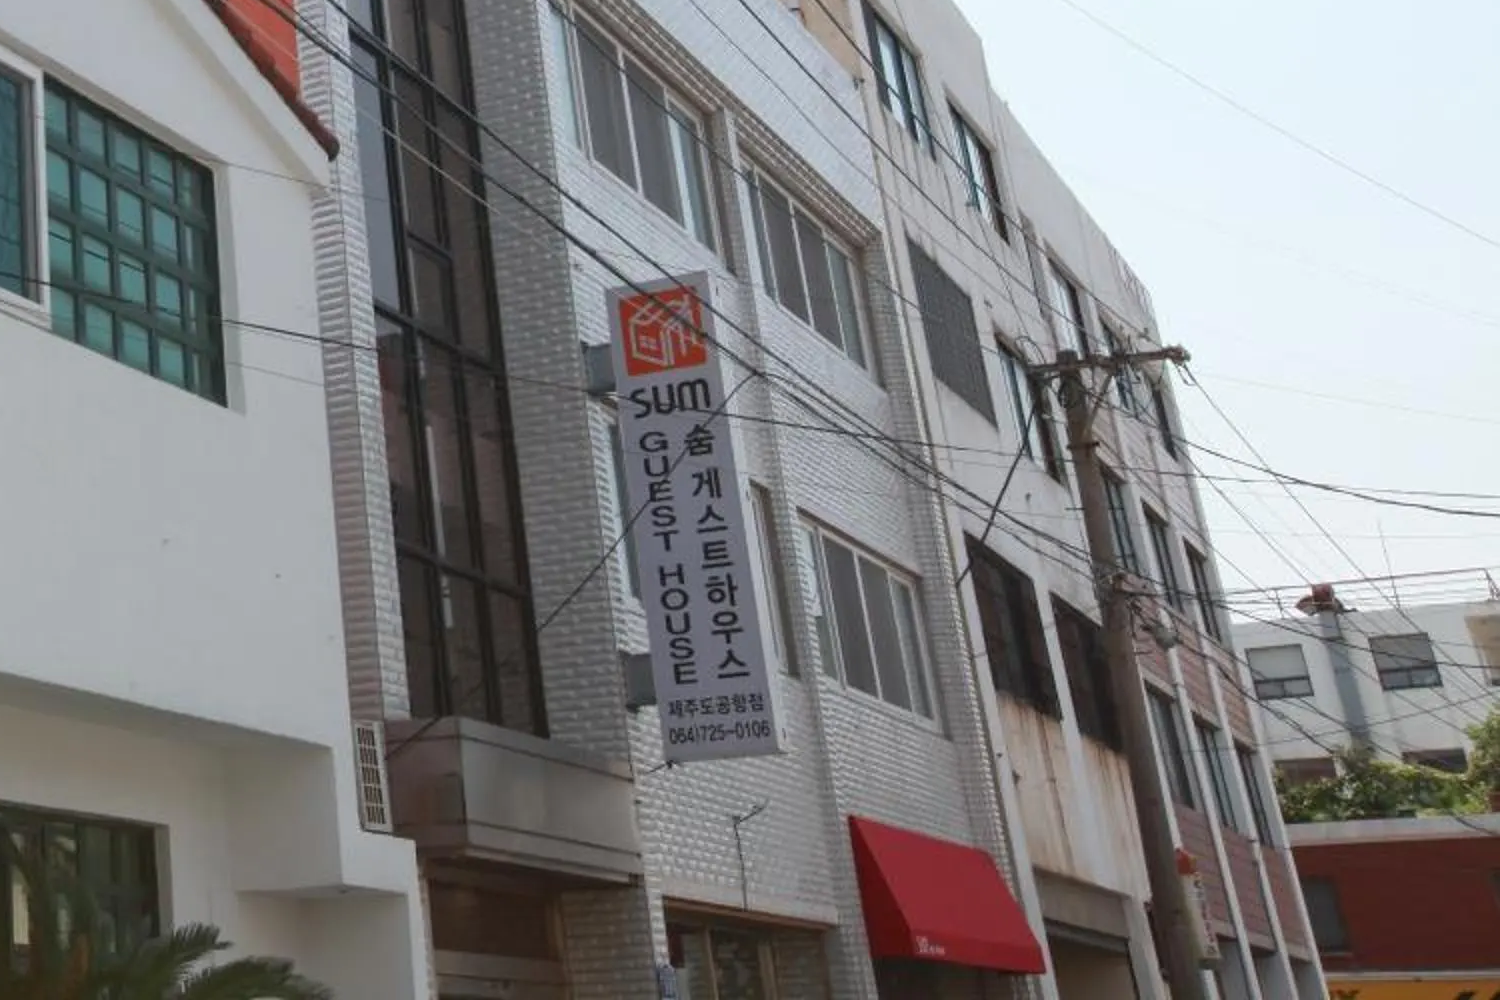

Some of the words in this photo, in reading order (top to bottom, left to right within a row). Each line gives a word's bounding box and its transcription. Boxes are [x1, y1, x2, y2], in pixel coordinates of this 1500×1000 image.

[630, 378, 711, 419] SUM
[640, 431, 680, 552] GUEST
[658, 563, 699, 685] HOUSE
[692, 466, 751, 679] 게스트하우스
